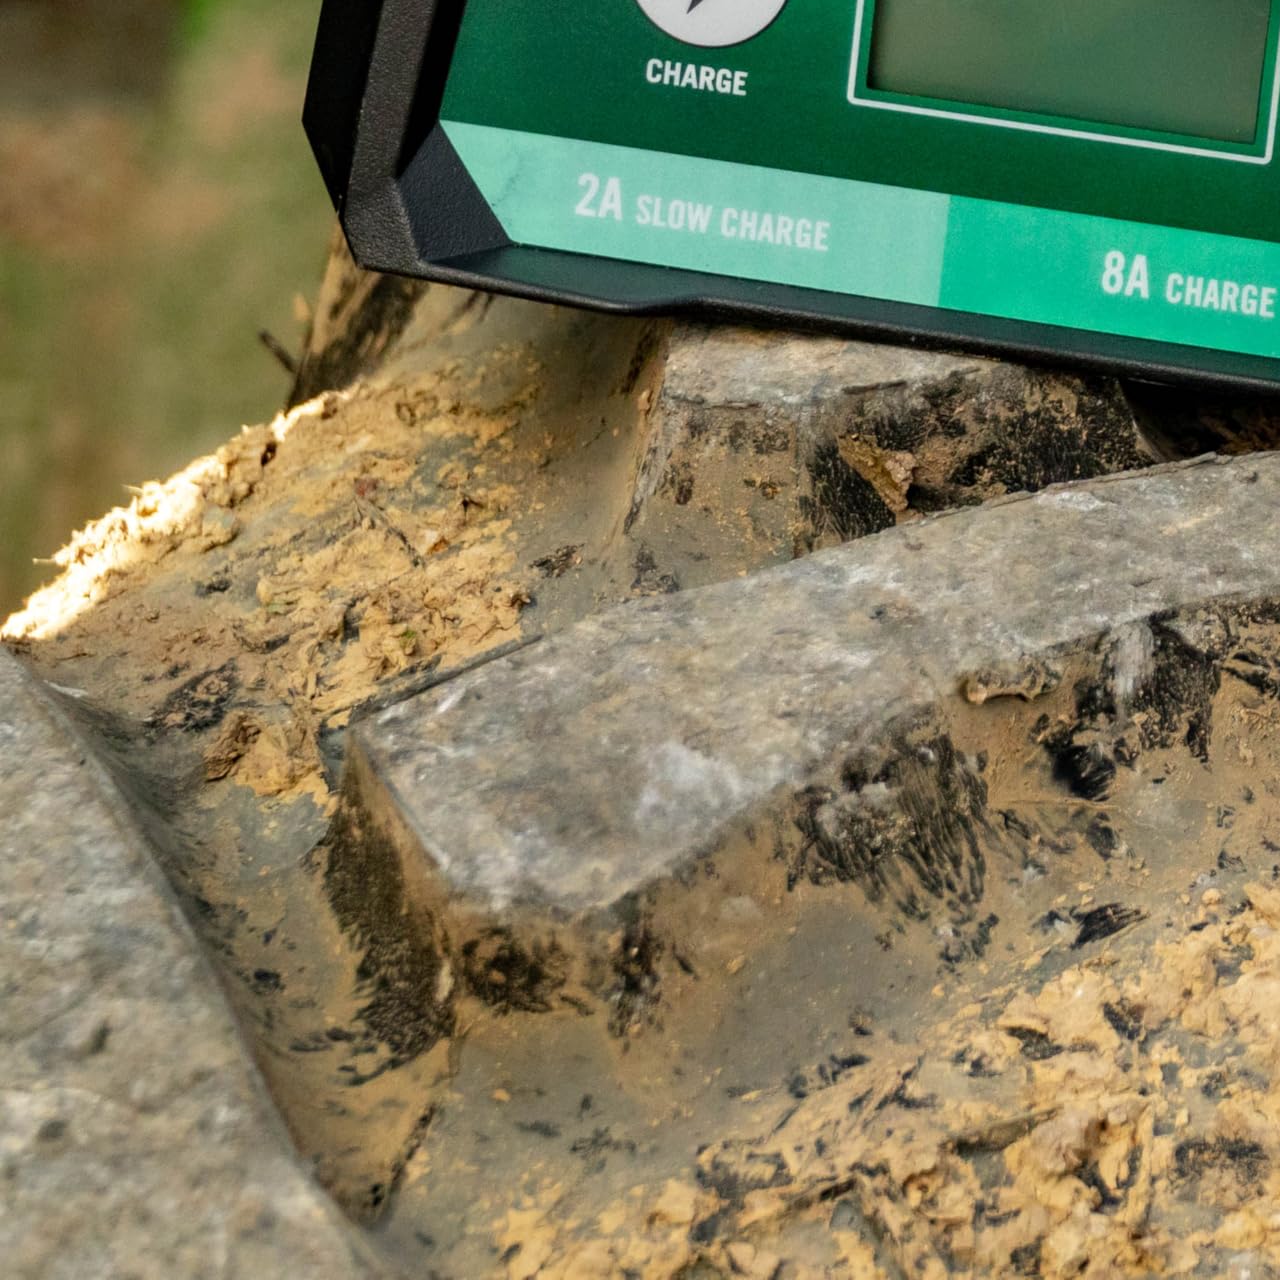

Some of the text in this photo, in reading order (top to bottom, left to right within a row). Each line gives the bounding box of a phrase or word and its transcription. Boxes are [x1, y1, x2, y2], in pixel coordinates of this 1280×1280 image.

[646, 58, 749, 97] CHARGE
[575, 173, 831, 253] 2A SLOW CHARGE
[1101, 250, 1277, 320] 8A CHARGE
